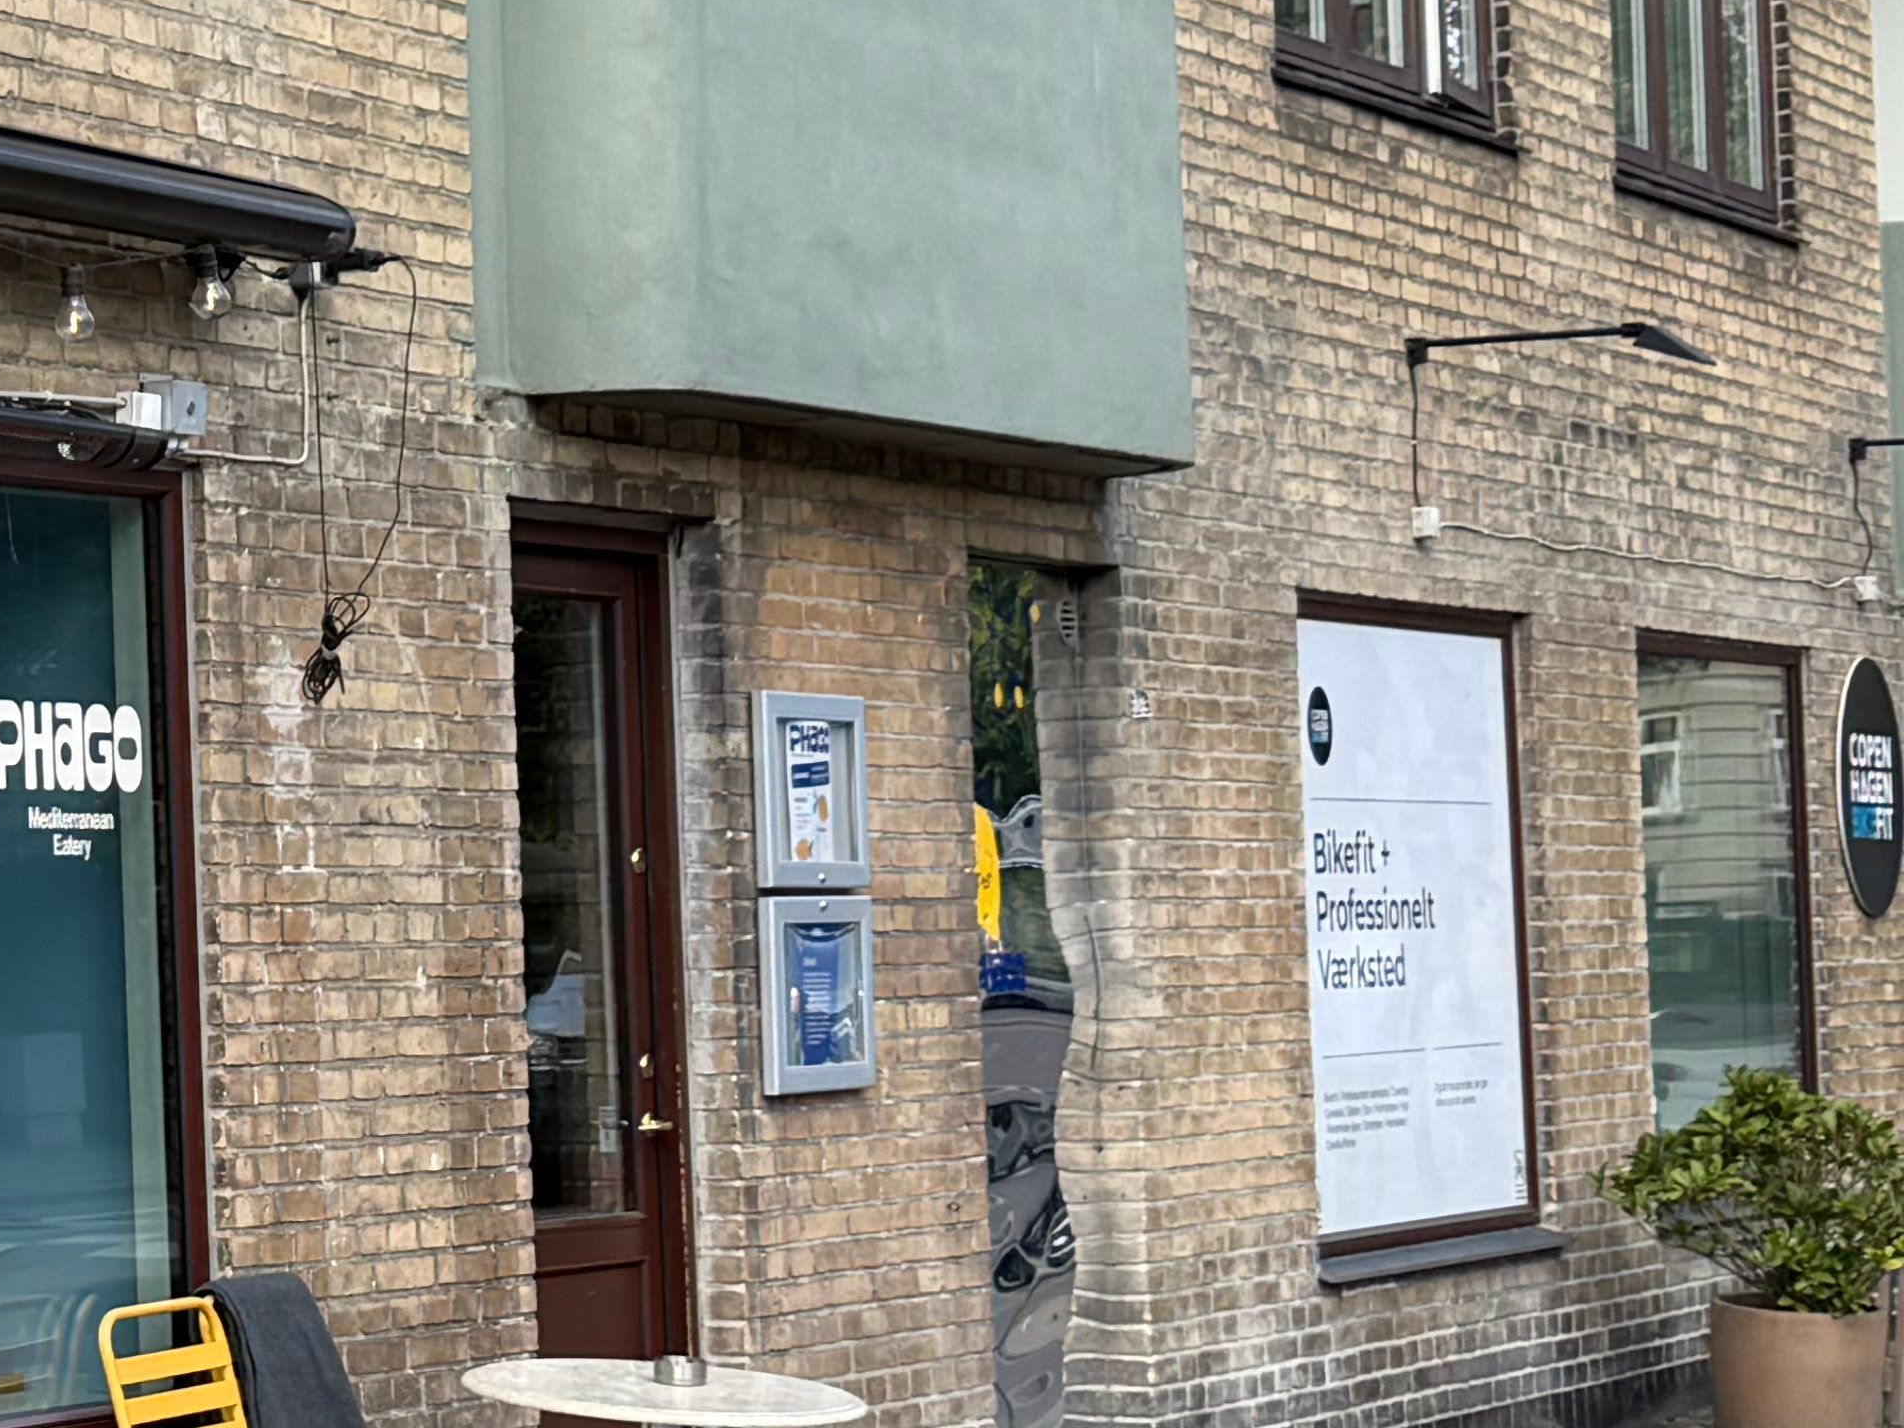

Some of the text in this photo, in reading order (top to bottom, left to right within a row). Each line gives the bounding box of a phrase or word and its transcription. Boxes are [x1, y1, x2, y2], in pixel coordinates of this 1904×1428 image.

[1849, 732, 1893, 768] COPEN
[28, 806, 115, 830] Mediterranean
[52, 833, 92, 861] Eatery
[1313, 828, 1391, 875] Bikefit +
[1316, 885, 1436, 933] Professionelt
[1317, 942, 1407, 990] Værksted
